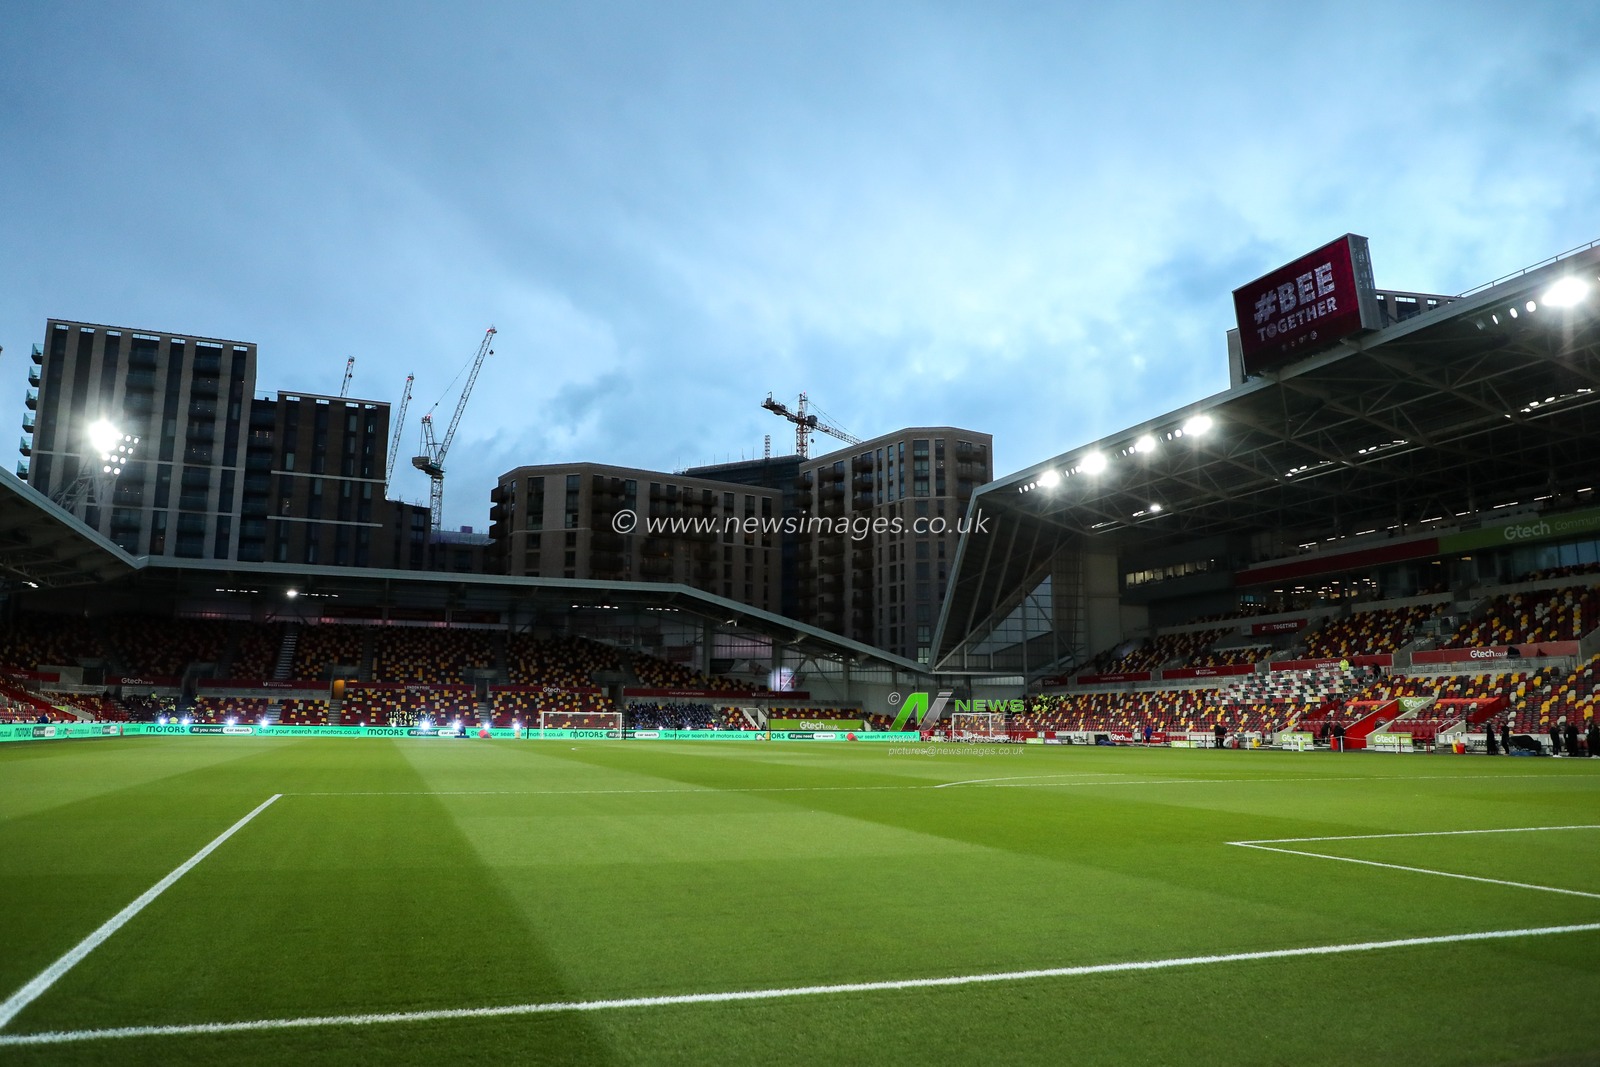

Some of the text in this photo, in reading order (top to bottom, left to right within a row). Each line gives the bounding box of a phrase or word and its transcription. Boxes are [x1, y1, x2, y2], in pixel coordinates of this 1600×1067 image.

[1254, 262, 1335, 325] #BEE
[1257, 296, 1338, 342] TOGETHER
[1504, 520, 1550, 540] Gtech
[800, 721, 838, 729] Gtech.co.uk
